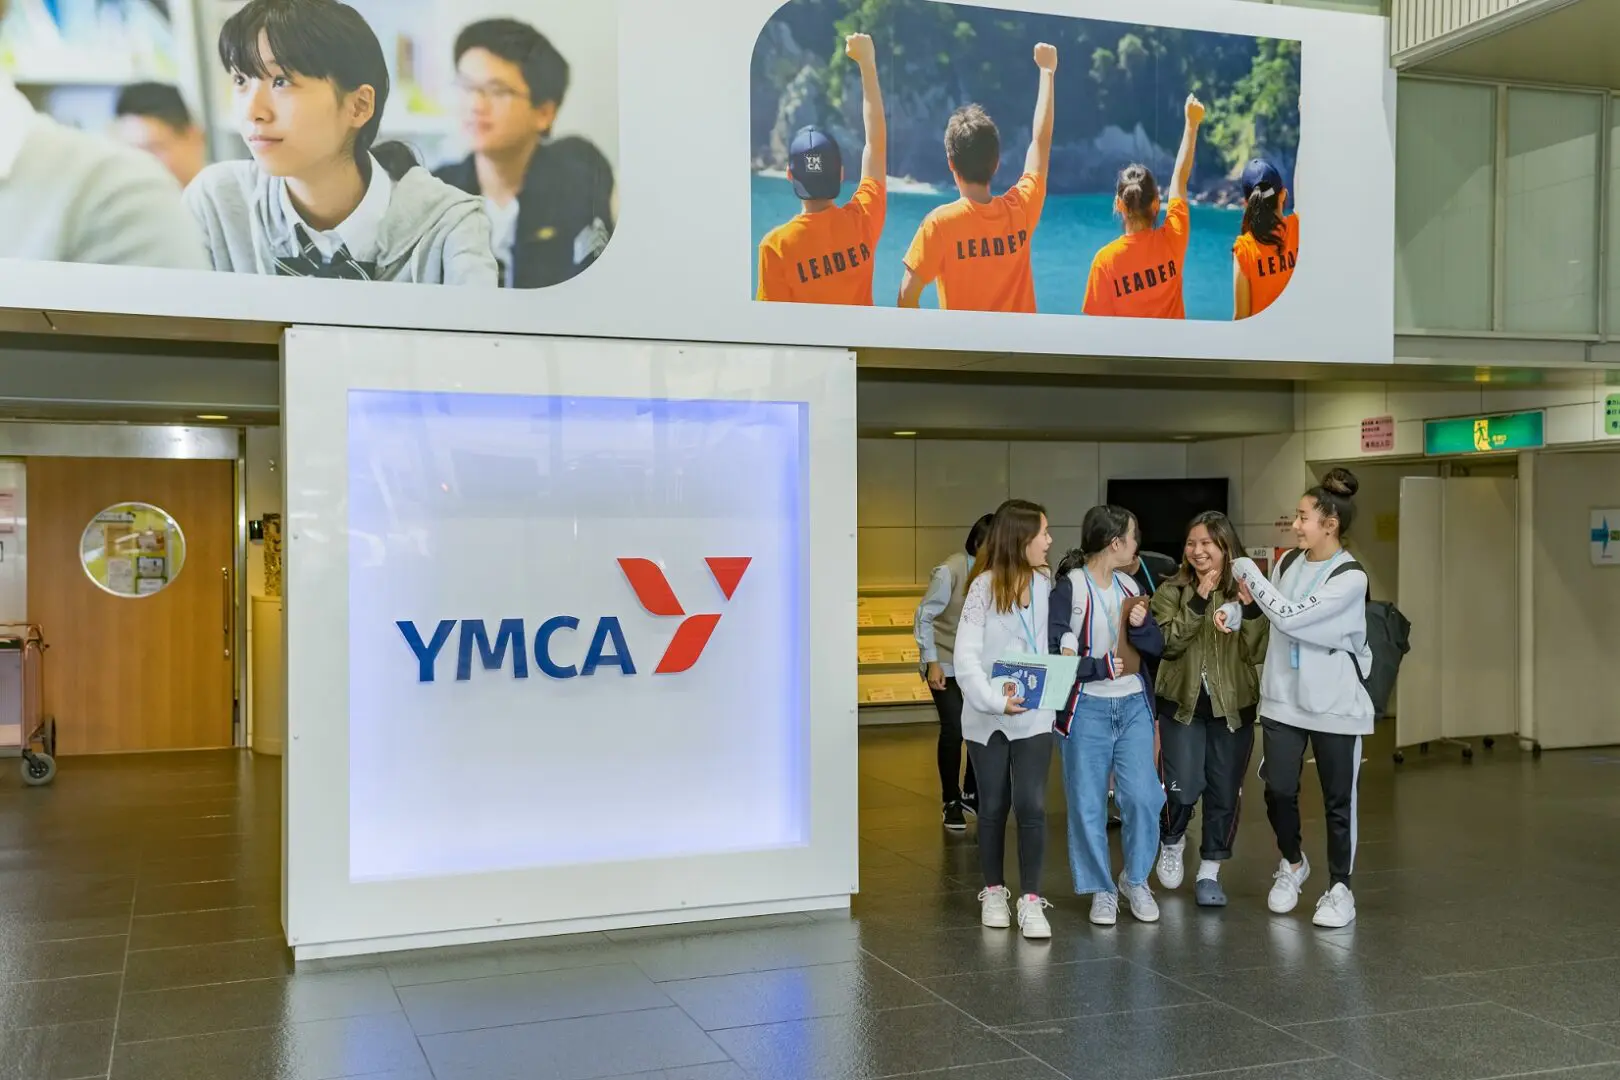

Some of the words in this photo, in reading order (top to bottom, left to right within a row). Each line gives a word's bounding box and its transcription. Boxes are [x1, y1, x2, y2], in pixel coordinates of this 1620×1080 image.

[797, 242, 871, 283] LEADER
[1114, 260, 1177, 298] LEADER
[1257, 250, 1297, 277] LEAD
[395, 615, 637, 682] YMCA
